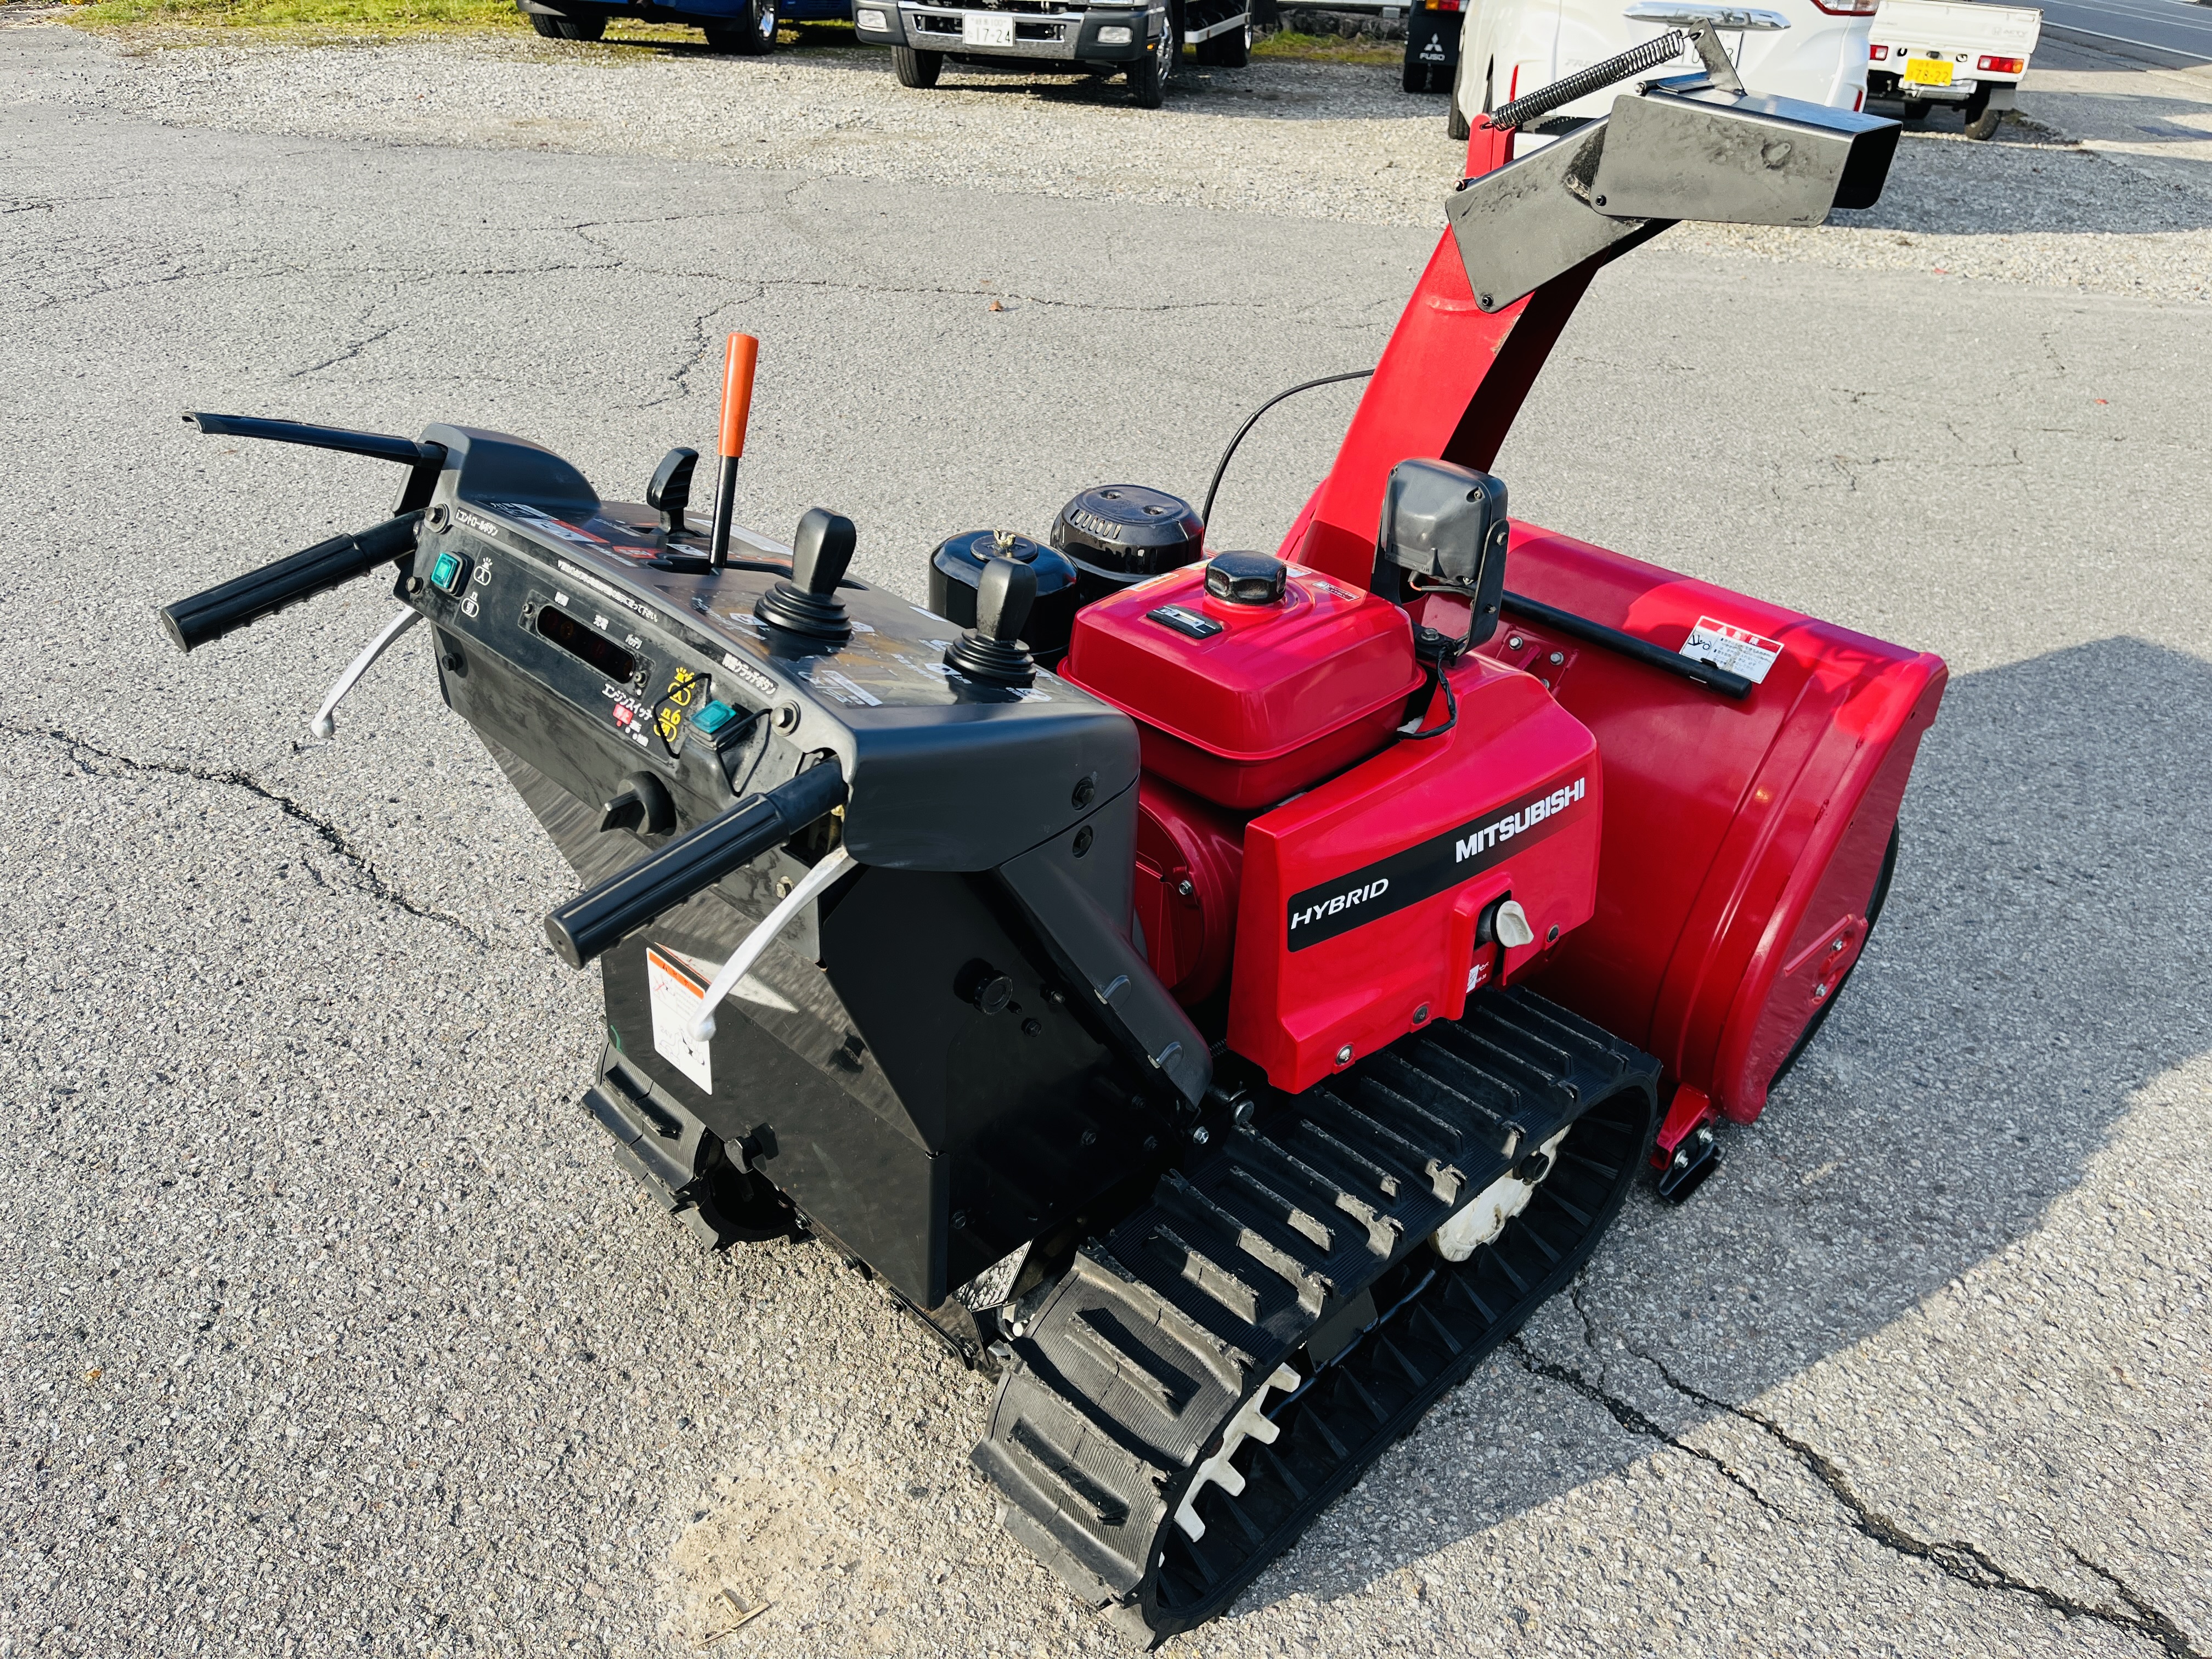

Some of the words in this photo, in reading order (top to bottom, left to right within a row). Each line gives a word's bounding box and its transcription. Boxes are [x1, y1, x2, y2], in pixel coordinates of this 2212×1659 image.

[977, 27, 1011, 43] 17-24
[1419, 53, 1445, 61] FUSO
[477, 569, 486, 583] 入
[601, 684, 653, 720] エンジンスイッチ
[1455, 777, 1585, 864] MITSUBISHI
[1290, 878, 1389, 930] HYBRID
